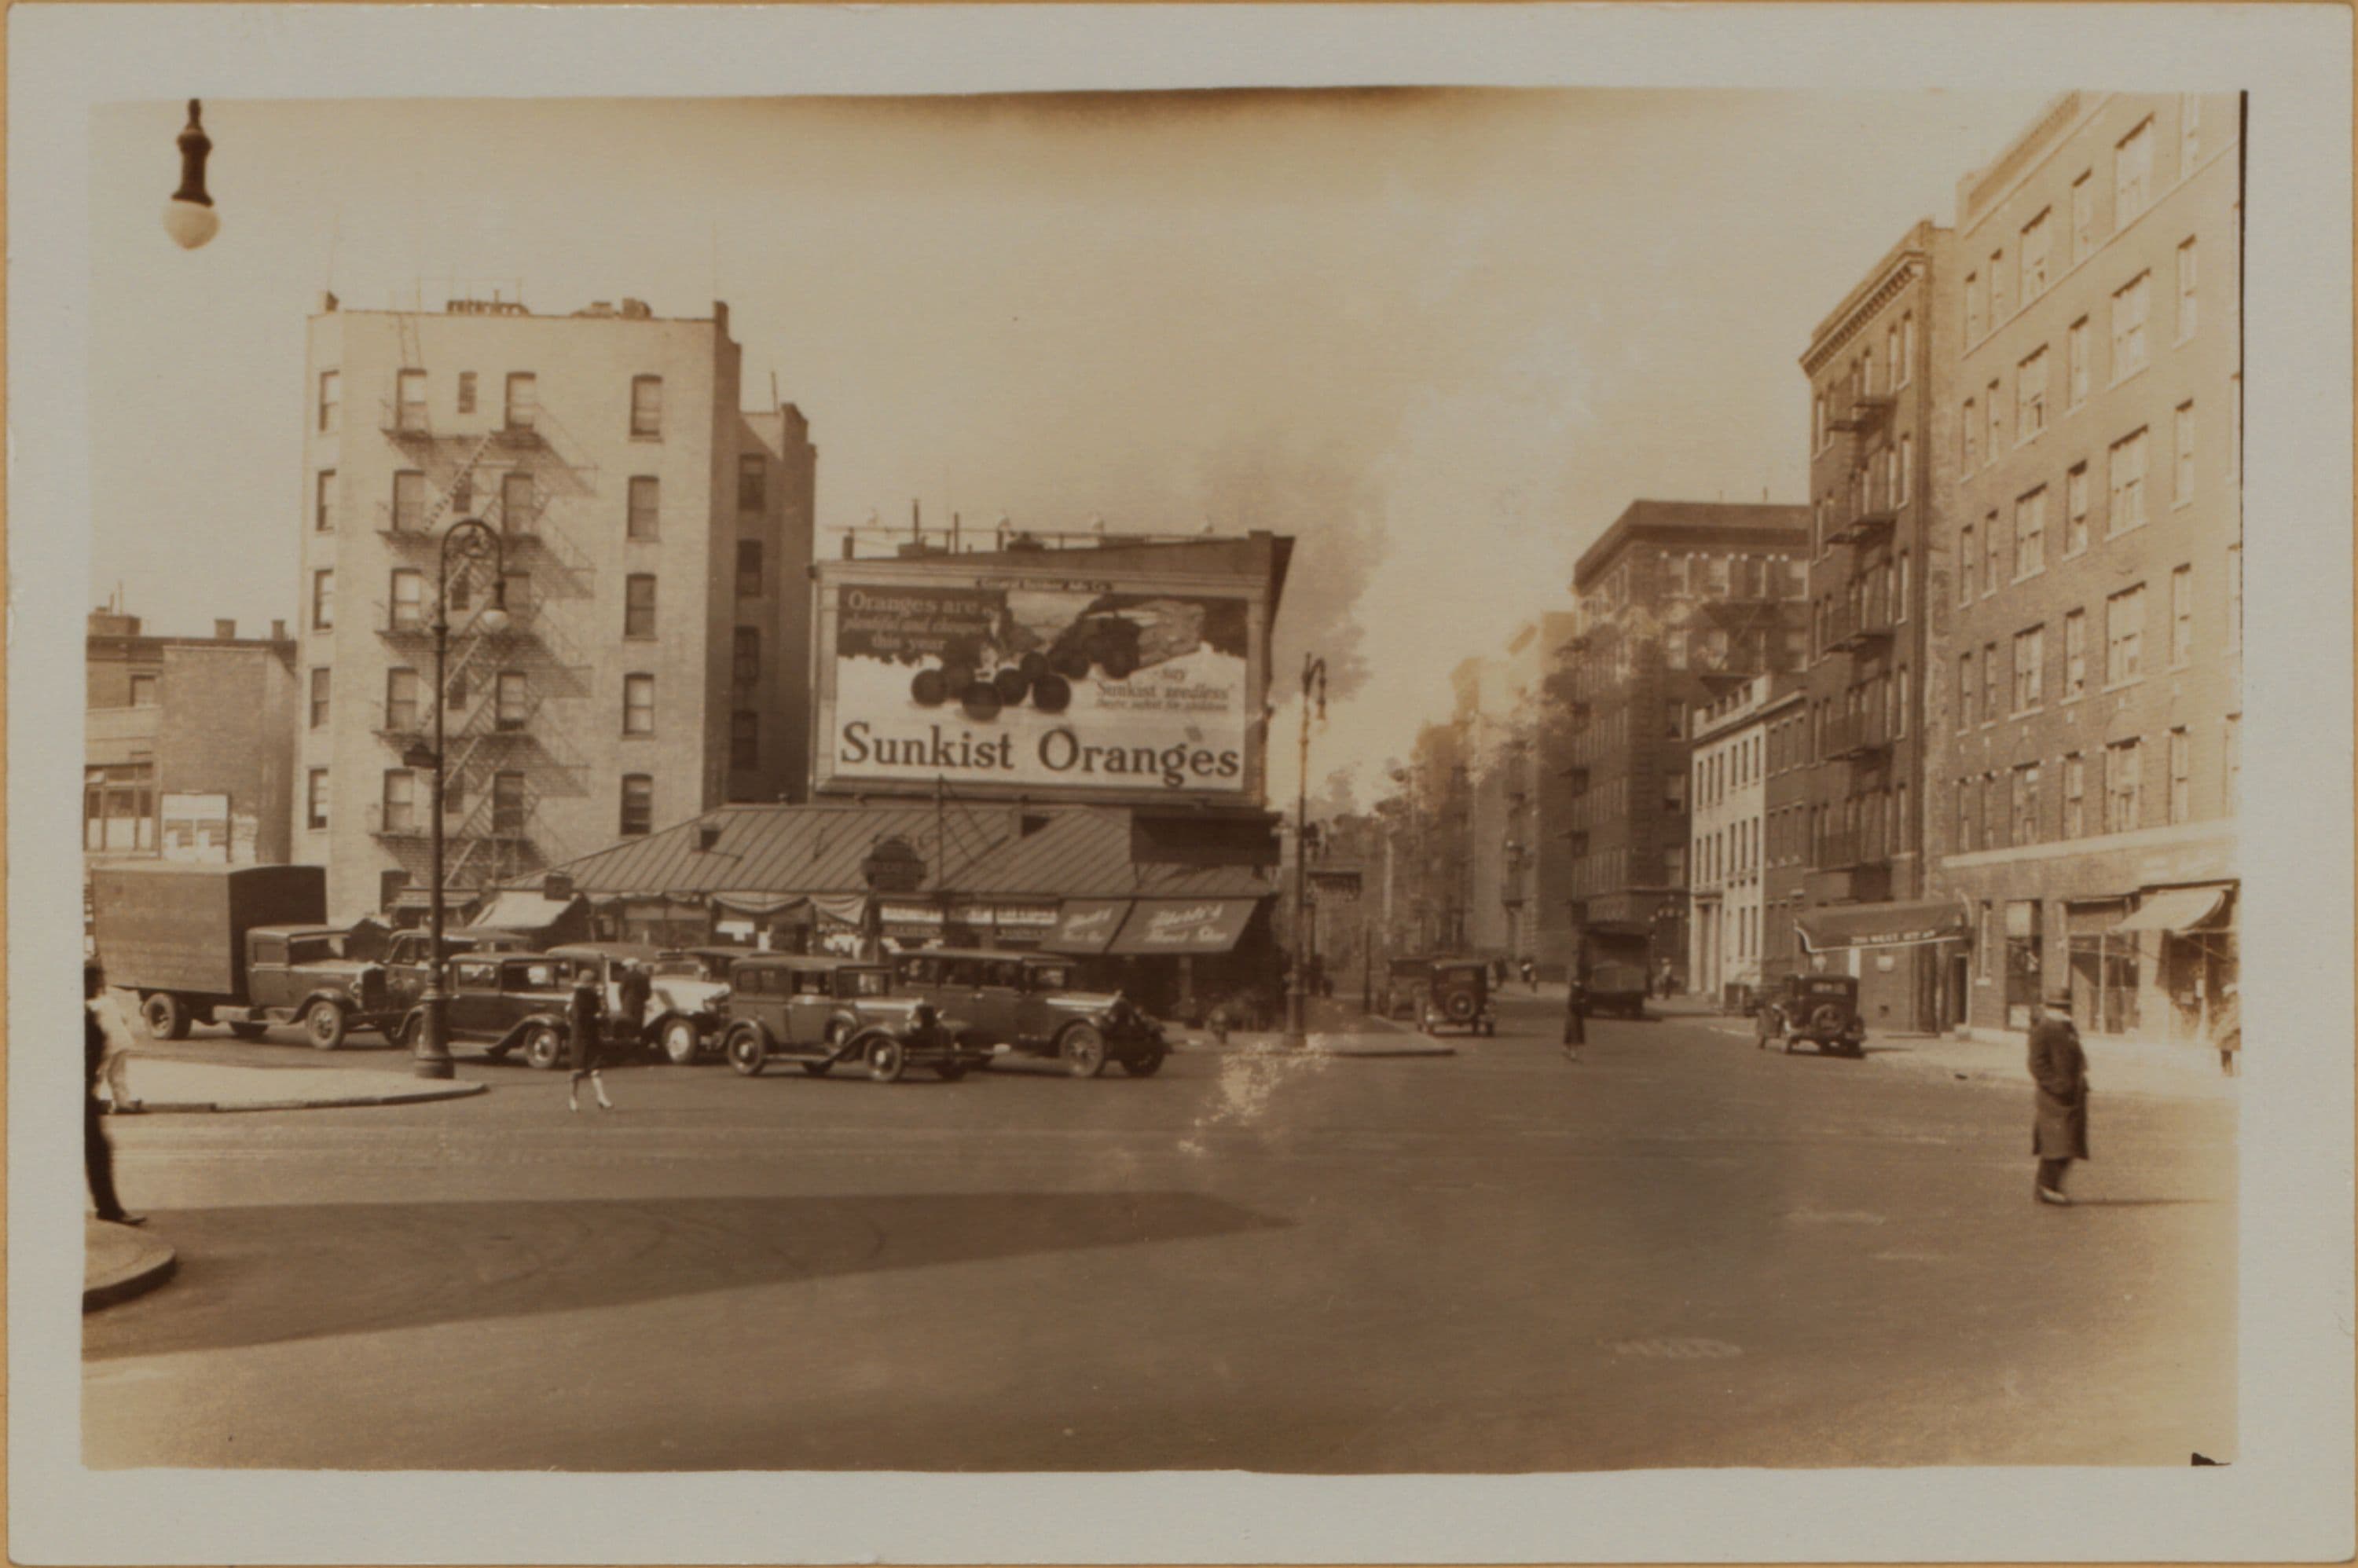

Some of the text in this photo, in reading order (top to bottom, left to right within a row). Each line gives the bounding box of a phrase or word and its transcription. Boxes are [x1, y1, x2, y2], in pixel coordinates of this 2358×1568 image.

[849, 591, 979, 616] Oranges are
[871, 633, 901, 650] this
[842, 721, 1239, 788] Sunkist Oranges
